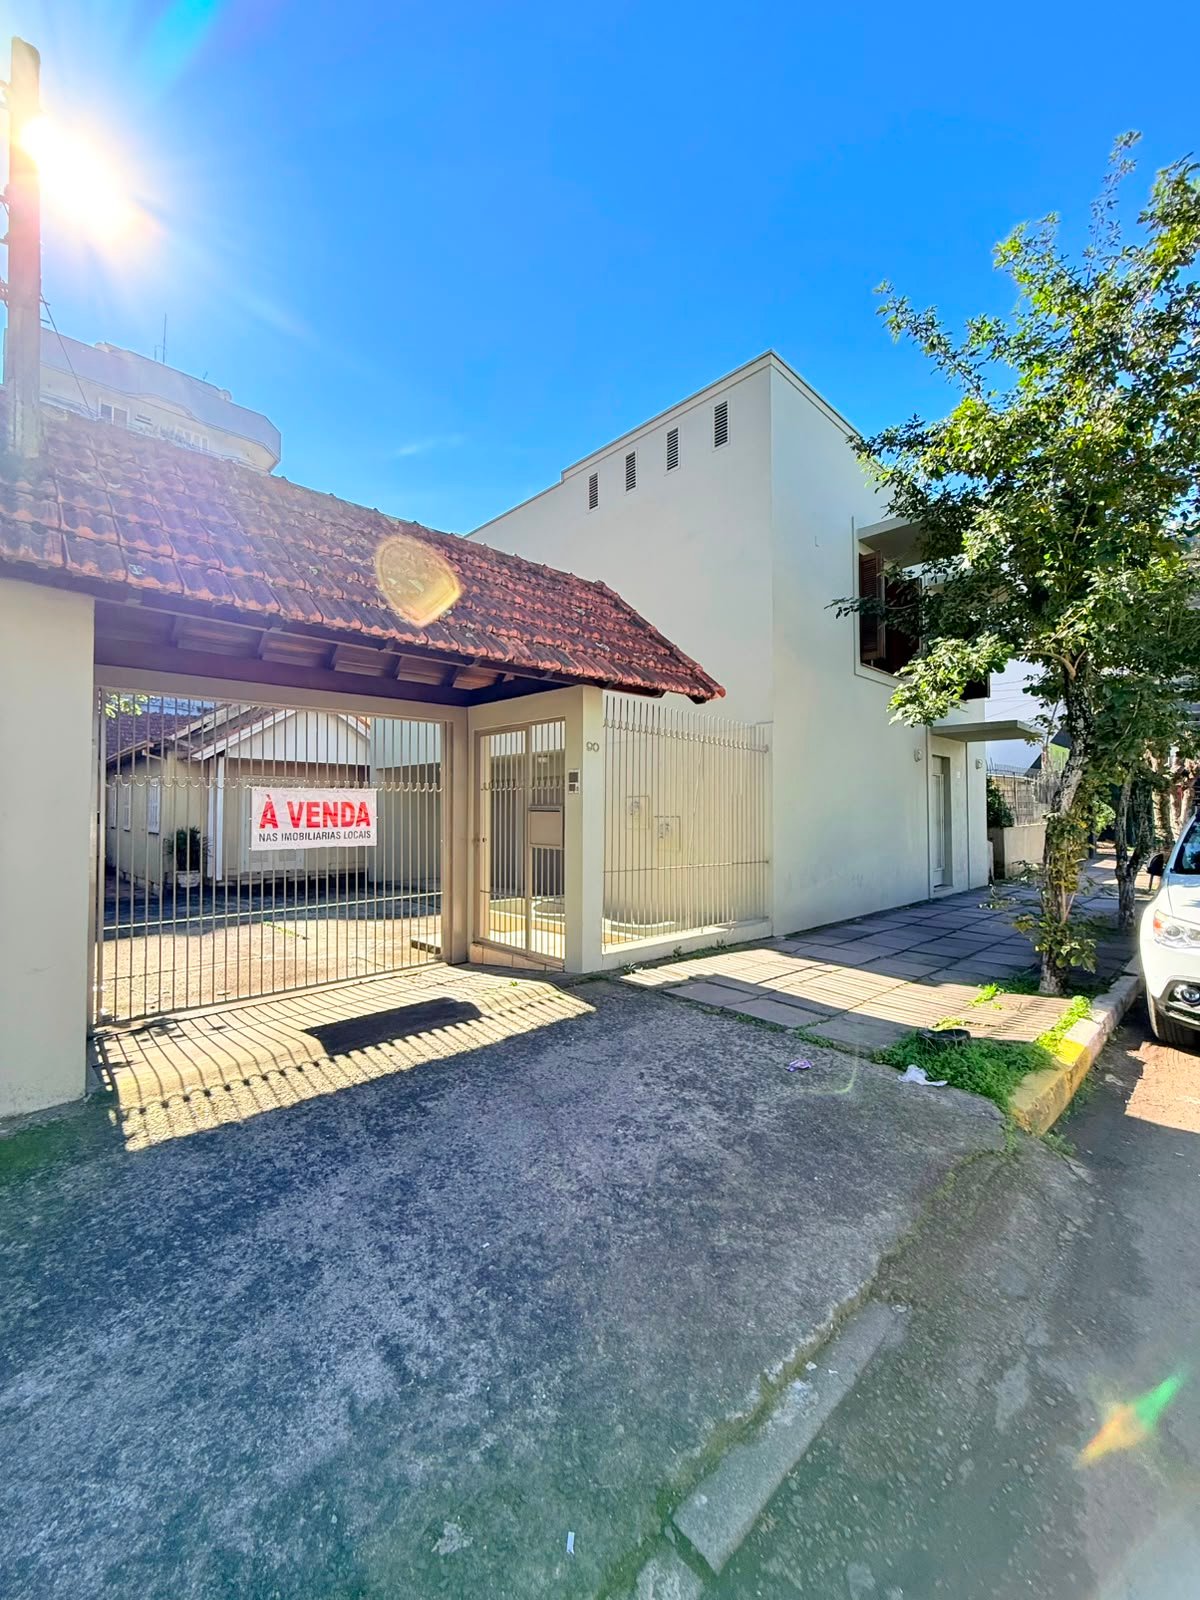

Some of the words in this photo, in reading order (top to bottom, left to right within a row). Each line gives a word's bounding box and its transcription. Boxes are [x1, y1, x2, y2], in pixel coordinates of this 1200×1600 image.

[586, 741, 600, 752] 90
[259, 794, 279, 829] À
[286, 801, 371, 829] VENDA
[258, 832, 278, 842] NAS
[343, 830, 371, 840] LOCAIS
